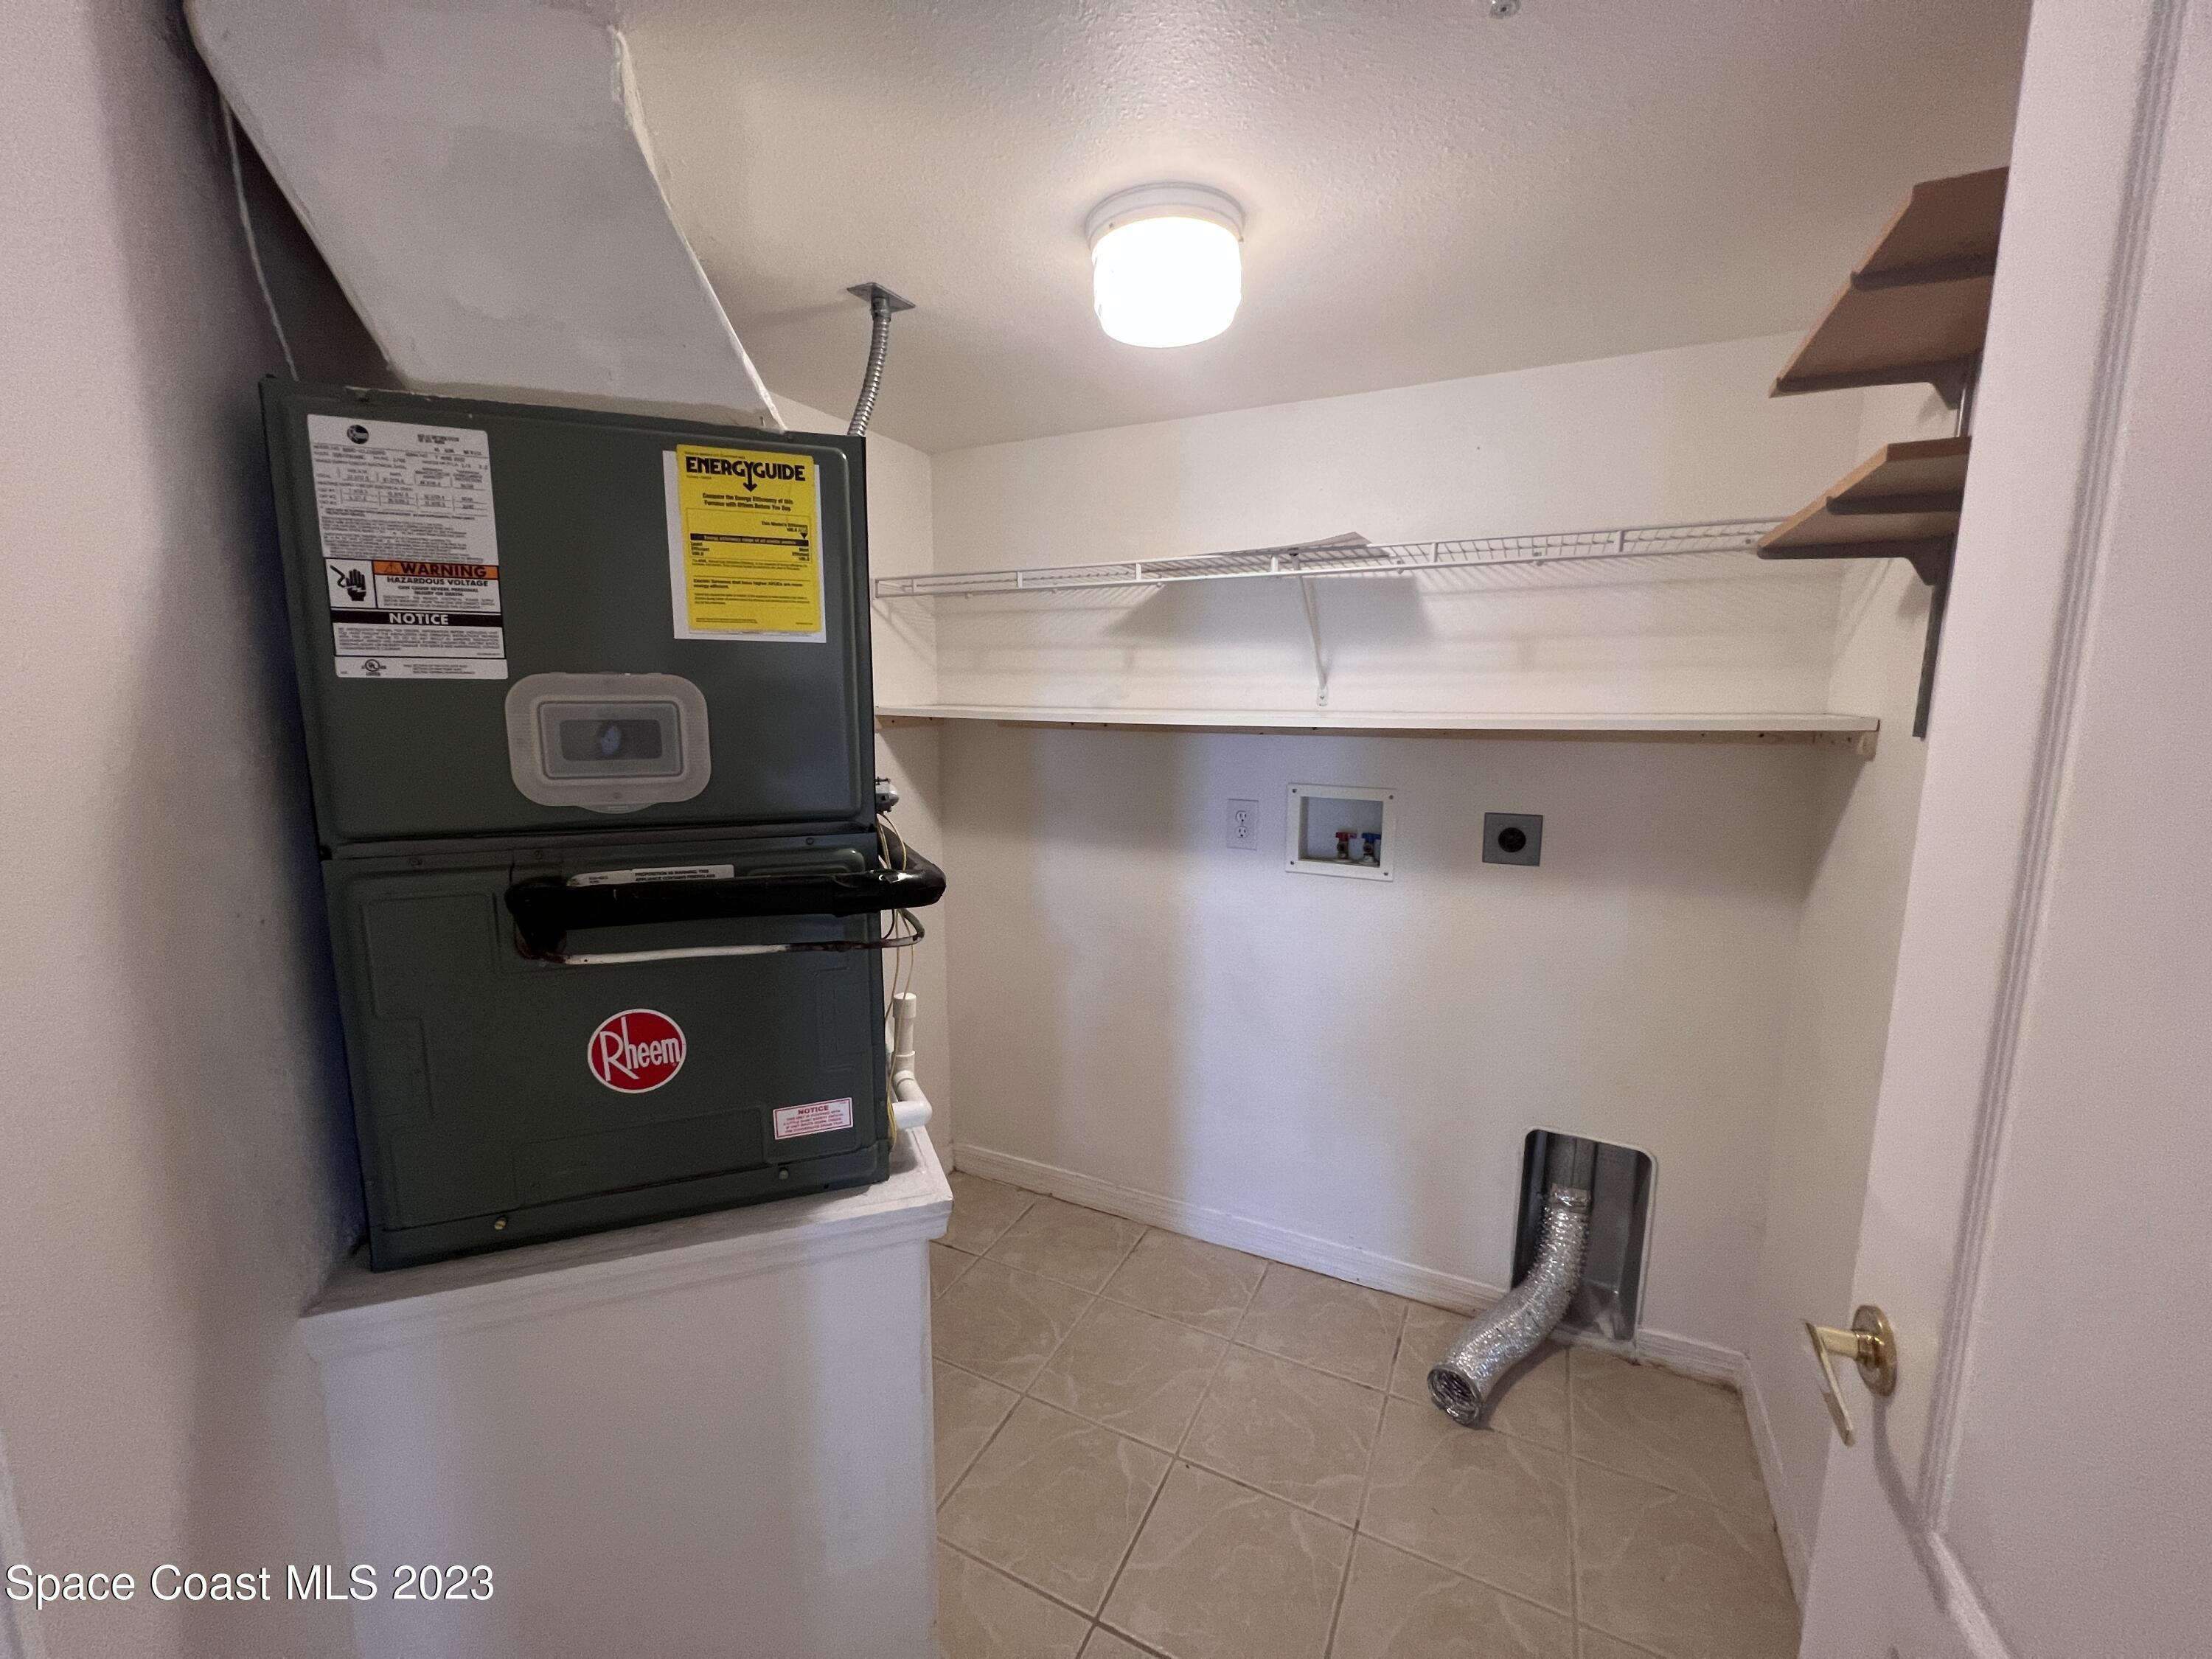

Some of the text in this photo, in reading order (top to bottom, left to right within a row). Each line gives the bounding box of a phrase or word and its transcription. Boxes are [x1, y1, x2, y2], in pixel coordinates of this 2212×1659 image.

[686, 456, 806, 481] ENERGYGUIDE
[401, 563, 487, 578] WARNING
[387, 576, 488, 587] HAZARDOUS VOLTAGE
[389, 612, 449, 625] NOTICE
[599, 1016, 681, 1082] Rheem
[798, 1105, 830, 1115] NOTICE
